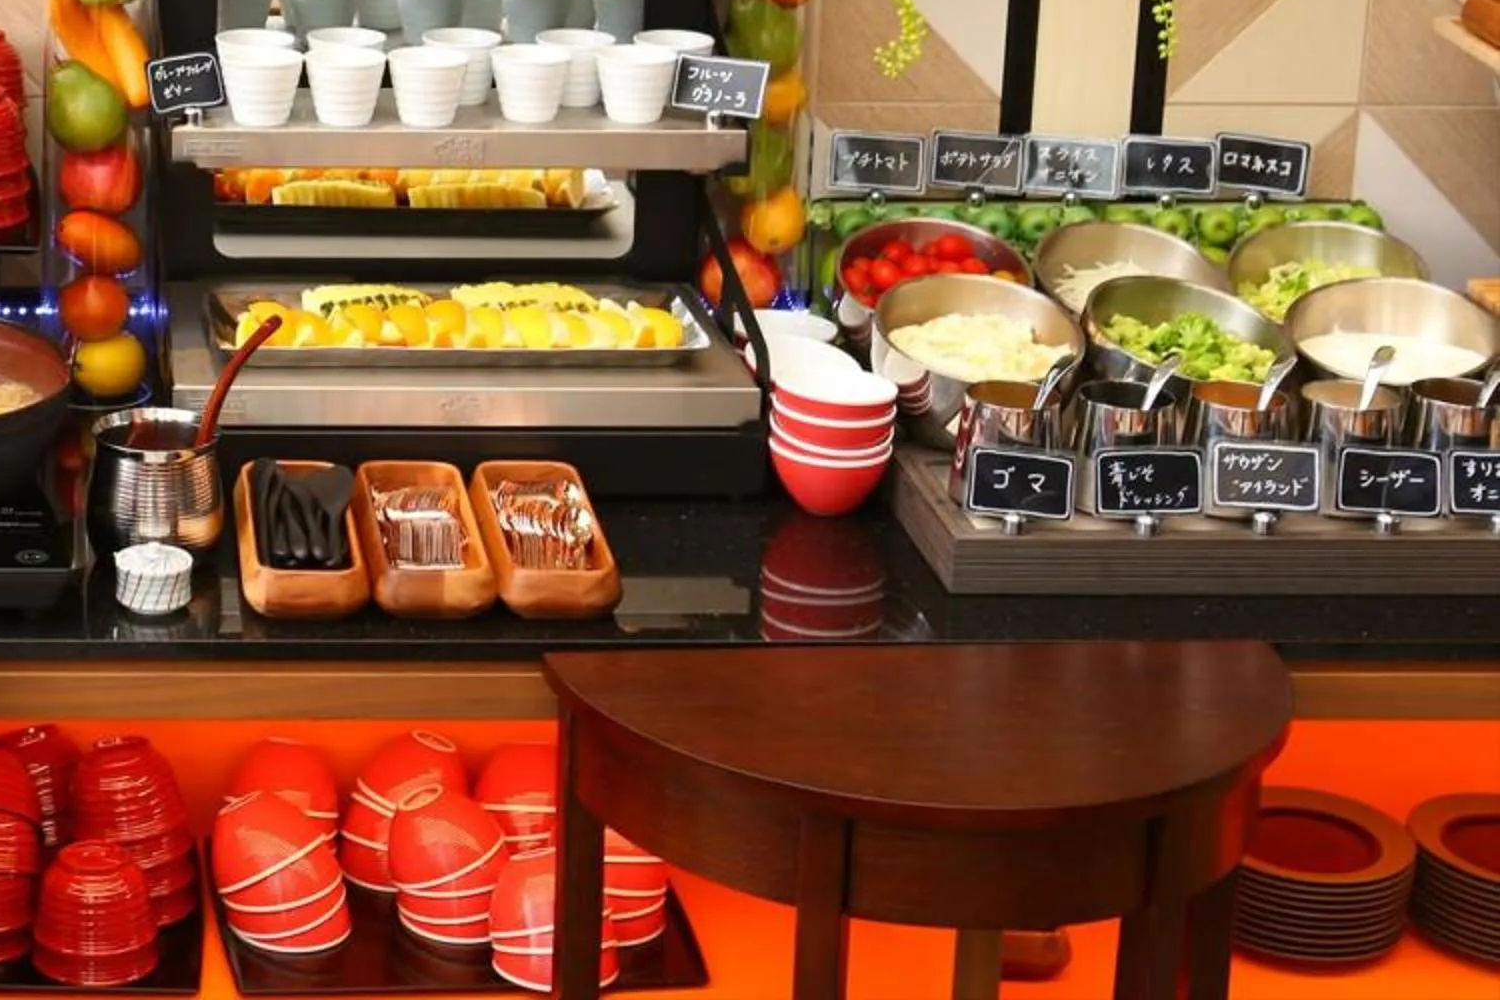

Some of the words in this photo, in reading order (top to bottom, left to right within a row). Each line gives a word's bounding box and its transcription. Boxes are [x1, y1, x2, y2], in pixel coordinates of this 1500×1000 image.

[687, 66, 733, 83] フルーツ
[691, 83, 747, 108] グラノーラ
[841, 150, 909, 172] プチトマト
[939, 150, 1017, 169] ポテトサラダ
[1038, 146, 1100, 162] スライス
[1146, 153, 1196, 174] レタス
[1222, 151, 1293, 177] ロマネスコ
[1222, 453, 1284, 472] サウザン
[992, 465, 1046, 494] ゴマ
[1107, 460, 1155, 487] 青じそ
[1359, 468, 1426, 489] シーザー
[1238, 476, 1310, 497] アイランド
[1118, 485, 1189, 510] ドレッシング
